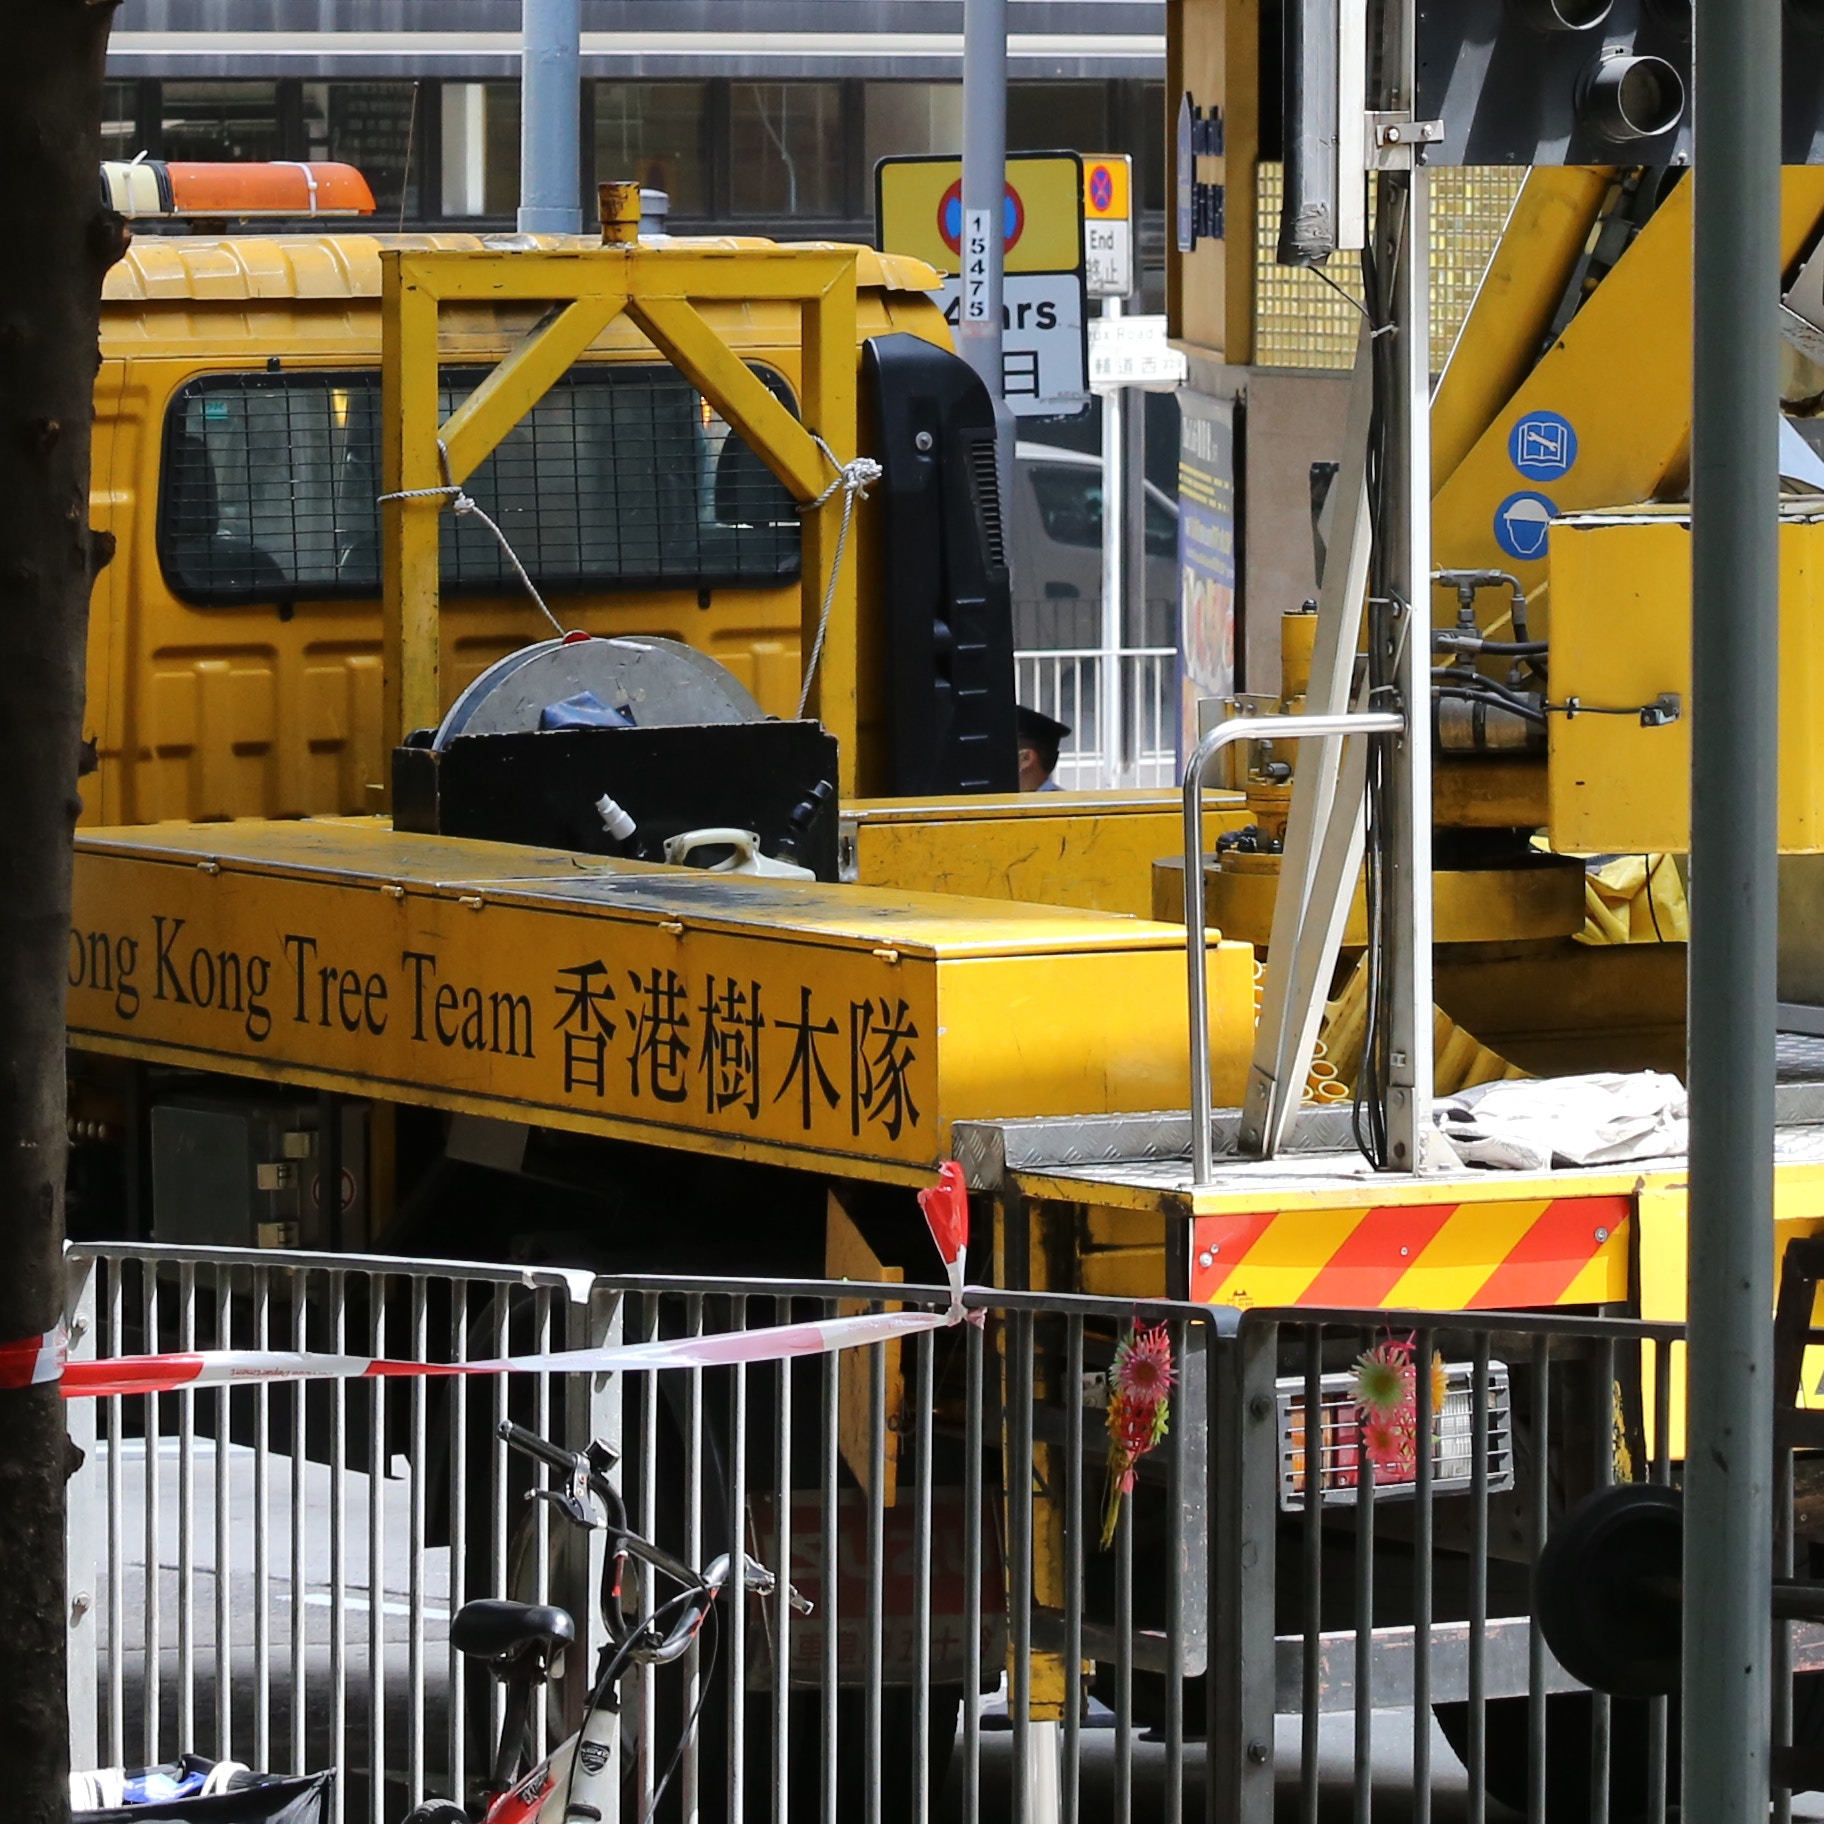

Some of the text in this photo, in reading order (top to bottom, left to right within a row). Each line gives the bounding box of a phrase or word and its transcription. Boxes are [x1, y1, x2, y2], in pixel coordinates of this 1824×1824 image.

[968, 216, 986, 318] 15475
[1090, 229, 1114, 251] End
[1116, 327, 1154, 341] Road
[151, 914, 272, 1042] Kong
[284, 933, 389, 1037] Tree
[402, 950, 535, 1061] Team
[552, 958, 922, 1142] 香港樹木隊
